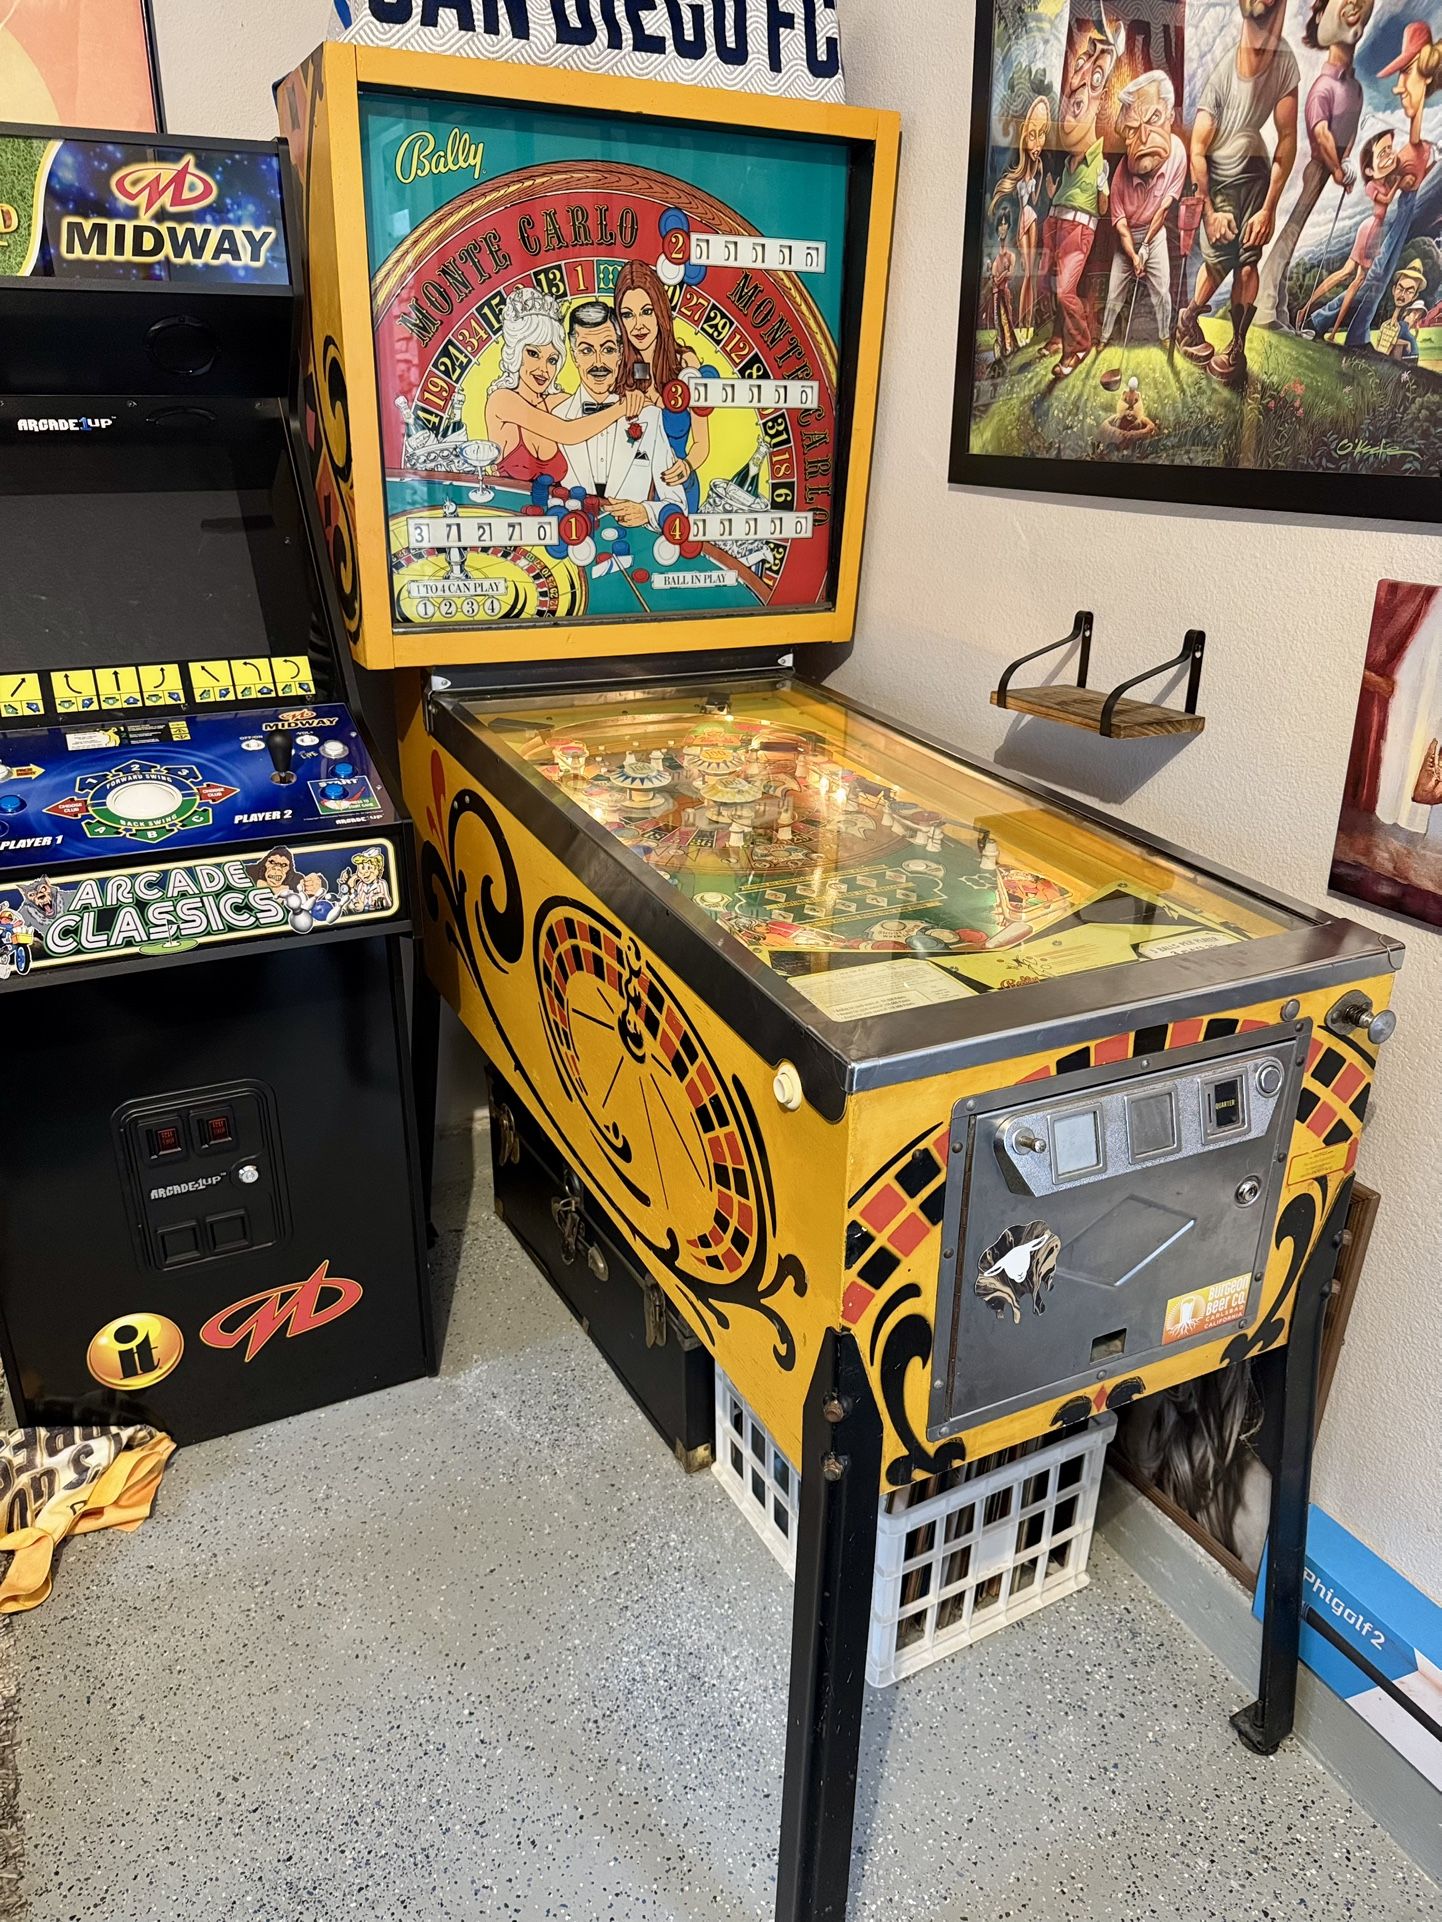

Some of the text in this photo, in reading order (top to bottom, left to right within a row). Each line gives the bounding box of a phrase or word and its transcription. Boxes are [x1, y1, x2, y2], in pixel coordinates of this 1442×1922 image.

[767, 0, 839, 79] FC
[395, 128, 484, 184] Bally
[65, 221, 273, 263] MIDWAY
[671, 233, 684, 259] 2
[398, 204, 638, 346] MONTE CARLO
[537, 265, 565, 295] 13
[574, 265, 589, 291] 1
[681, 291, 708, 321] 27
[457, 318, 489, 352] 34
[703, 309, 730, 341] 29
[725, 332, 749, 363] 12
[438, 343, 469, 381] 24
[423, 377, 450, 410] 19
[671, 384, 684, 409] 3
[771, 453, 791, 478] 18
[568, 517, 579, 540] 1
[671, 517, 682, 540] 4
[422, 583, 438, 595] TO
[440, 582, 446, 594] 4
[448, 582, 473, 594] CAN
[474, 581, 501, 593] PLAY
[664, 573, 727, 586] BALL IN PLAY
[422, 600, 495, 616] 1 2 3 4
[263, 718, 338, 731] MIDWAY
[106, 773, 173, 790] FORWARD SWING
[120, 814, 178, 828] BACK SWING
[234, 811, 281, 824] PLAYER
[281, 810, 293, 819] 2
[0, 835, 64, 851] PLAYER 1
[69, 860, 255, 911] ARCADE
[46, 888, 285, 956] CLASSICS
[1215, 1099, 1236, 1110] QUARTER
[1204, 1312, 1243, 1329] CALIFORNIA
[1205, 1304, 1244, 1322] CARLSBAD
